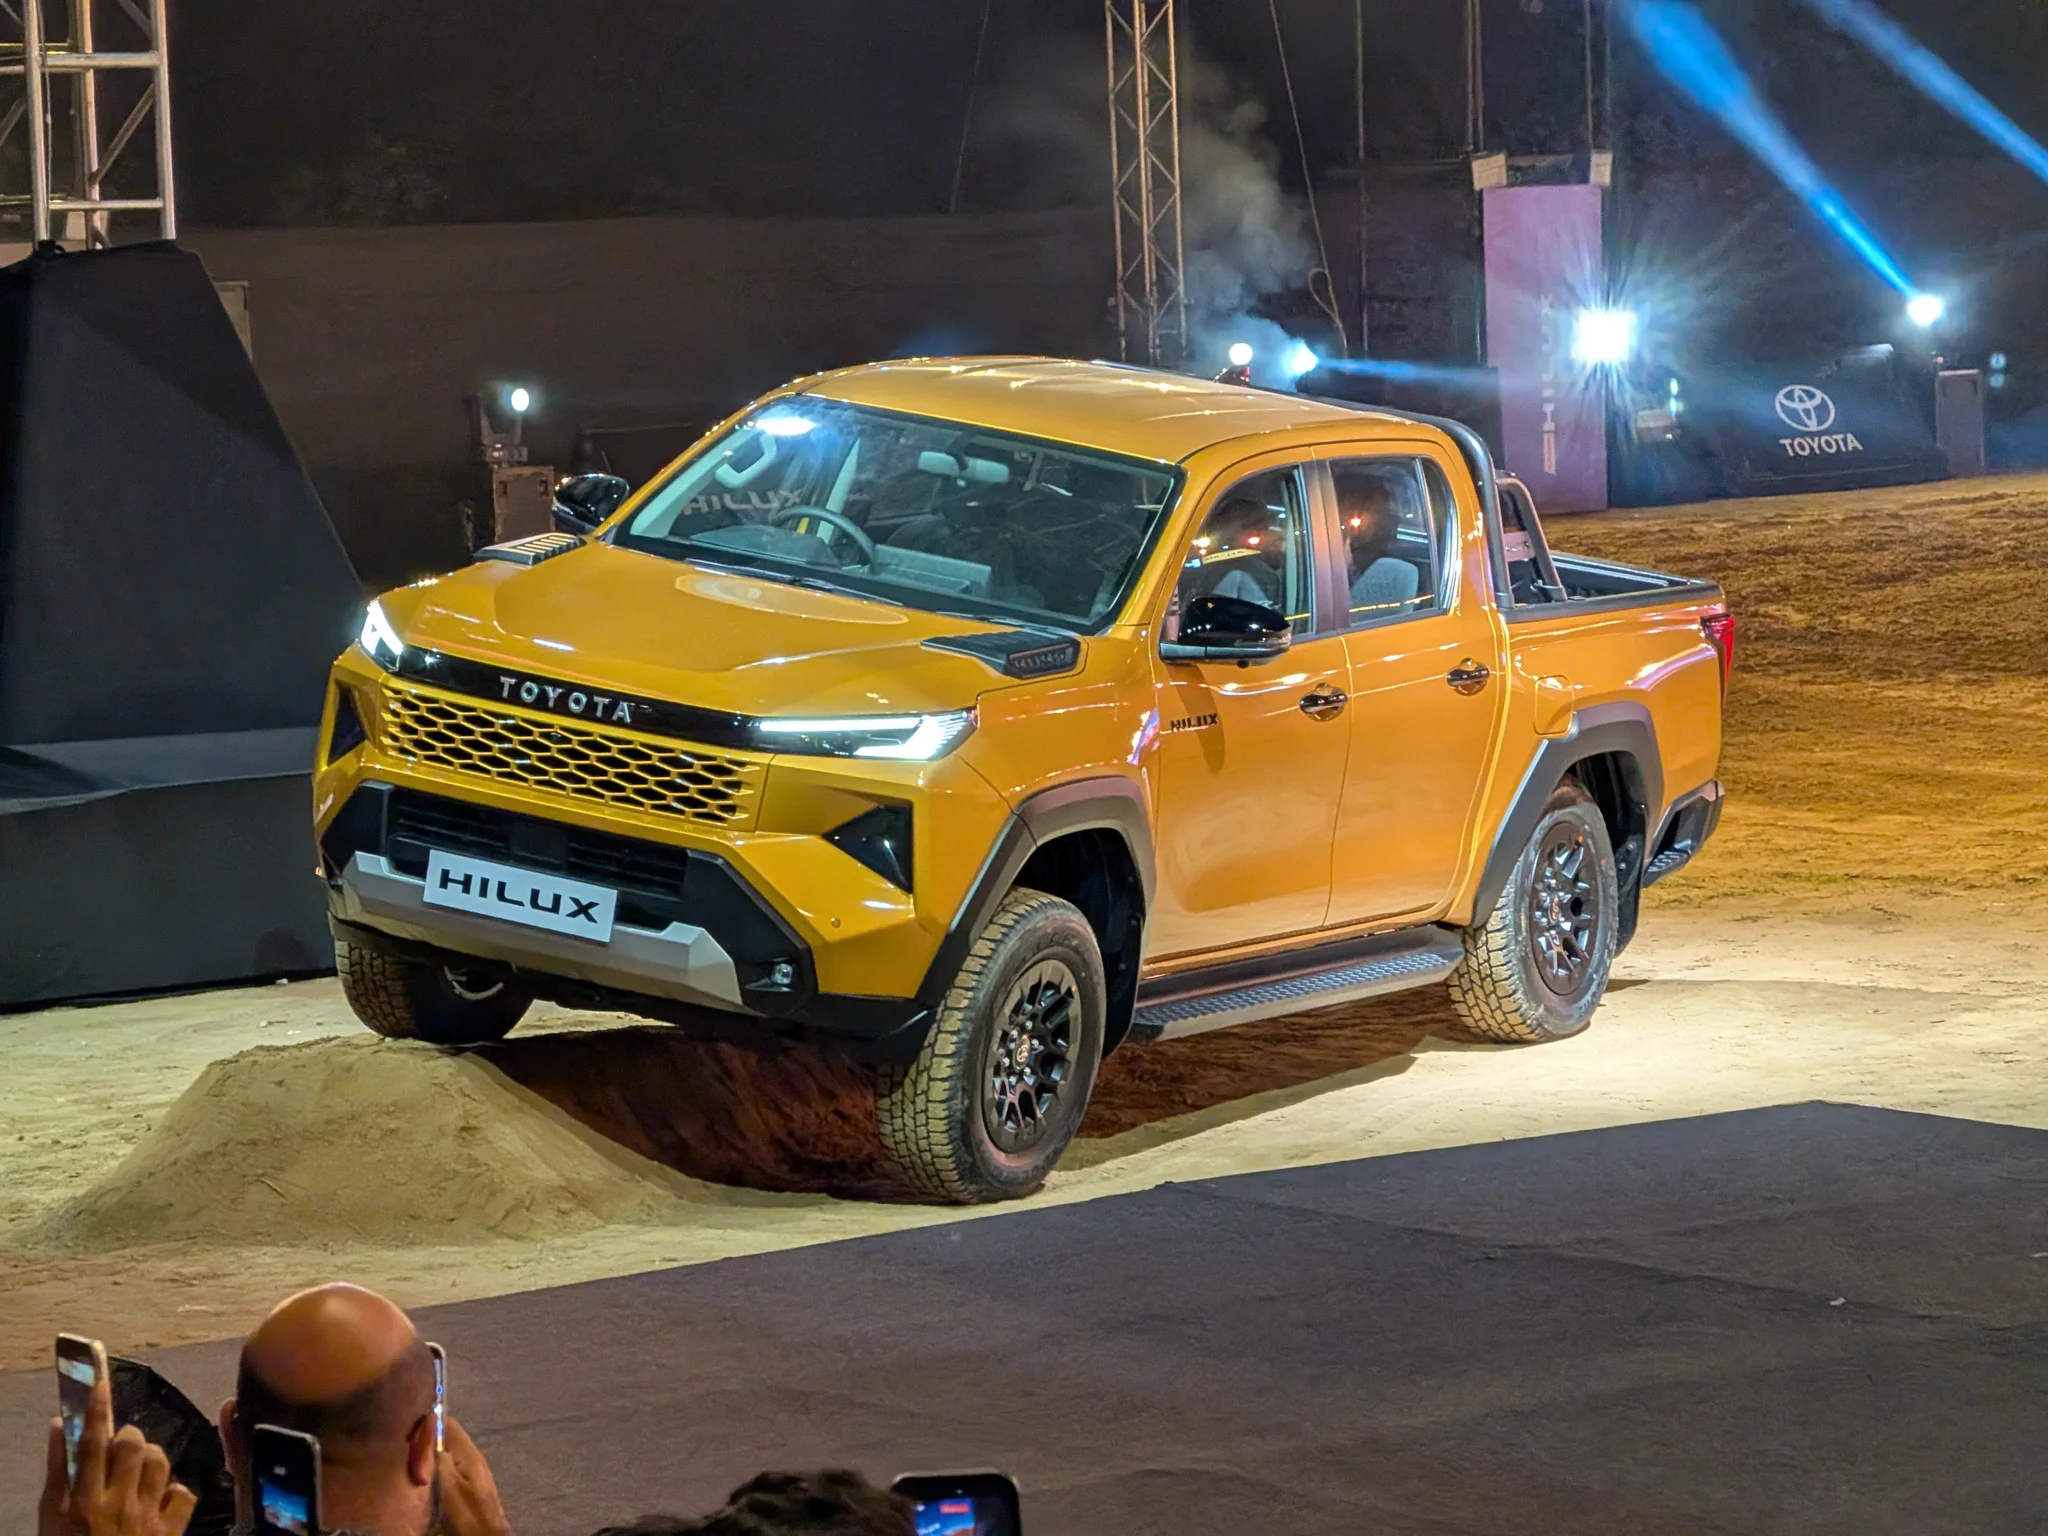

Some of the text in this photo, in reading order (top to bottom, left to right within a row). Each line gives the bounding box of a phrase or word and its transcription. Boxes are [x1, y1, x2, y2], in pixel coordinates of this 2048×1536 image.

[1779, 433, 1863, 456] TOYOTA
[500, 676, 632, 724] TOYOTA
[1170, 713, 1218, 732] HILUX
[438, 868, 600, 924] HILUX
